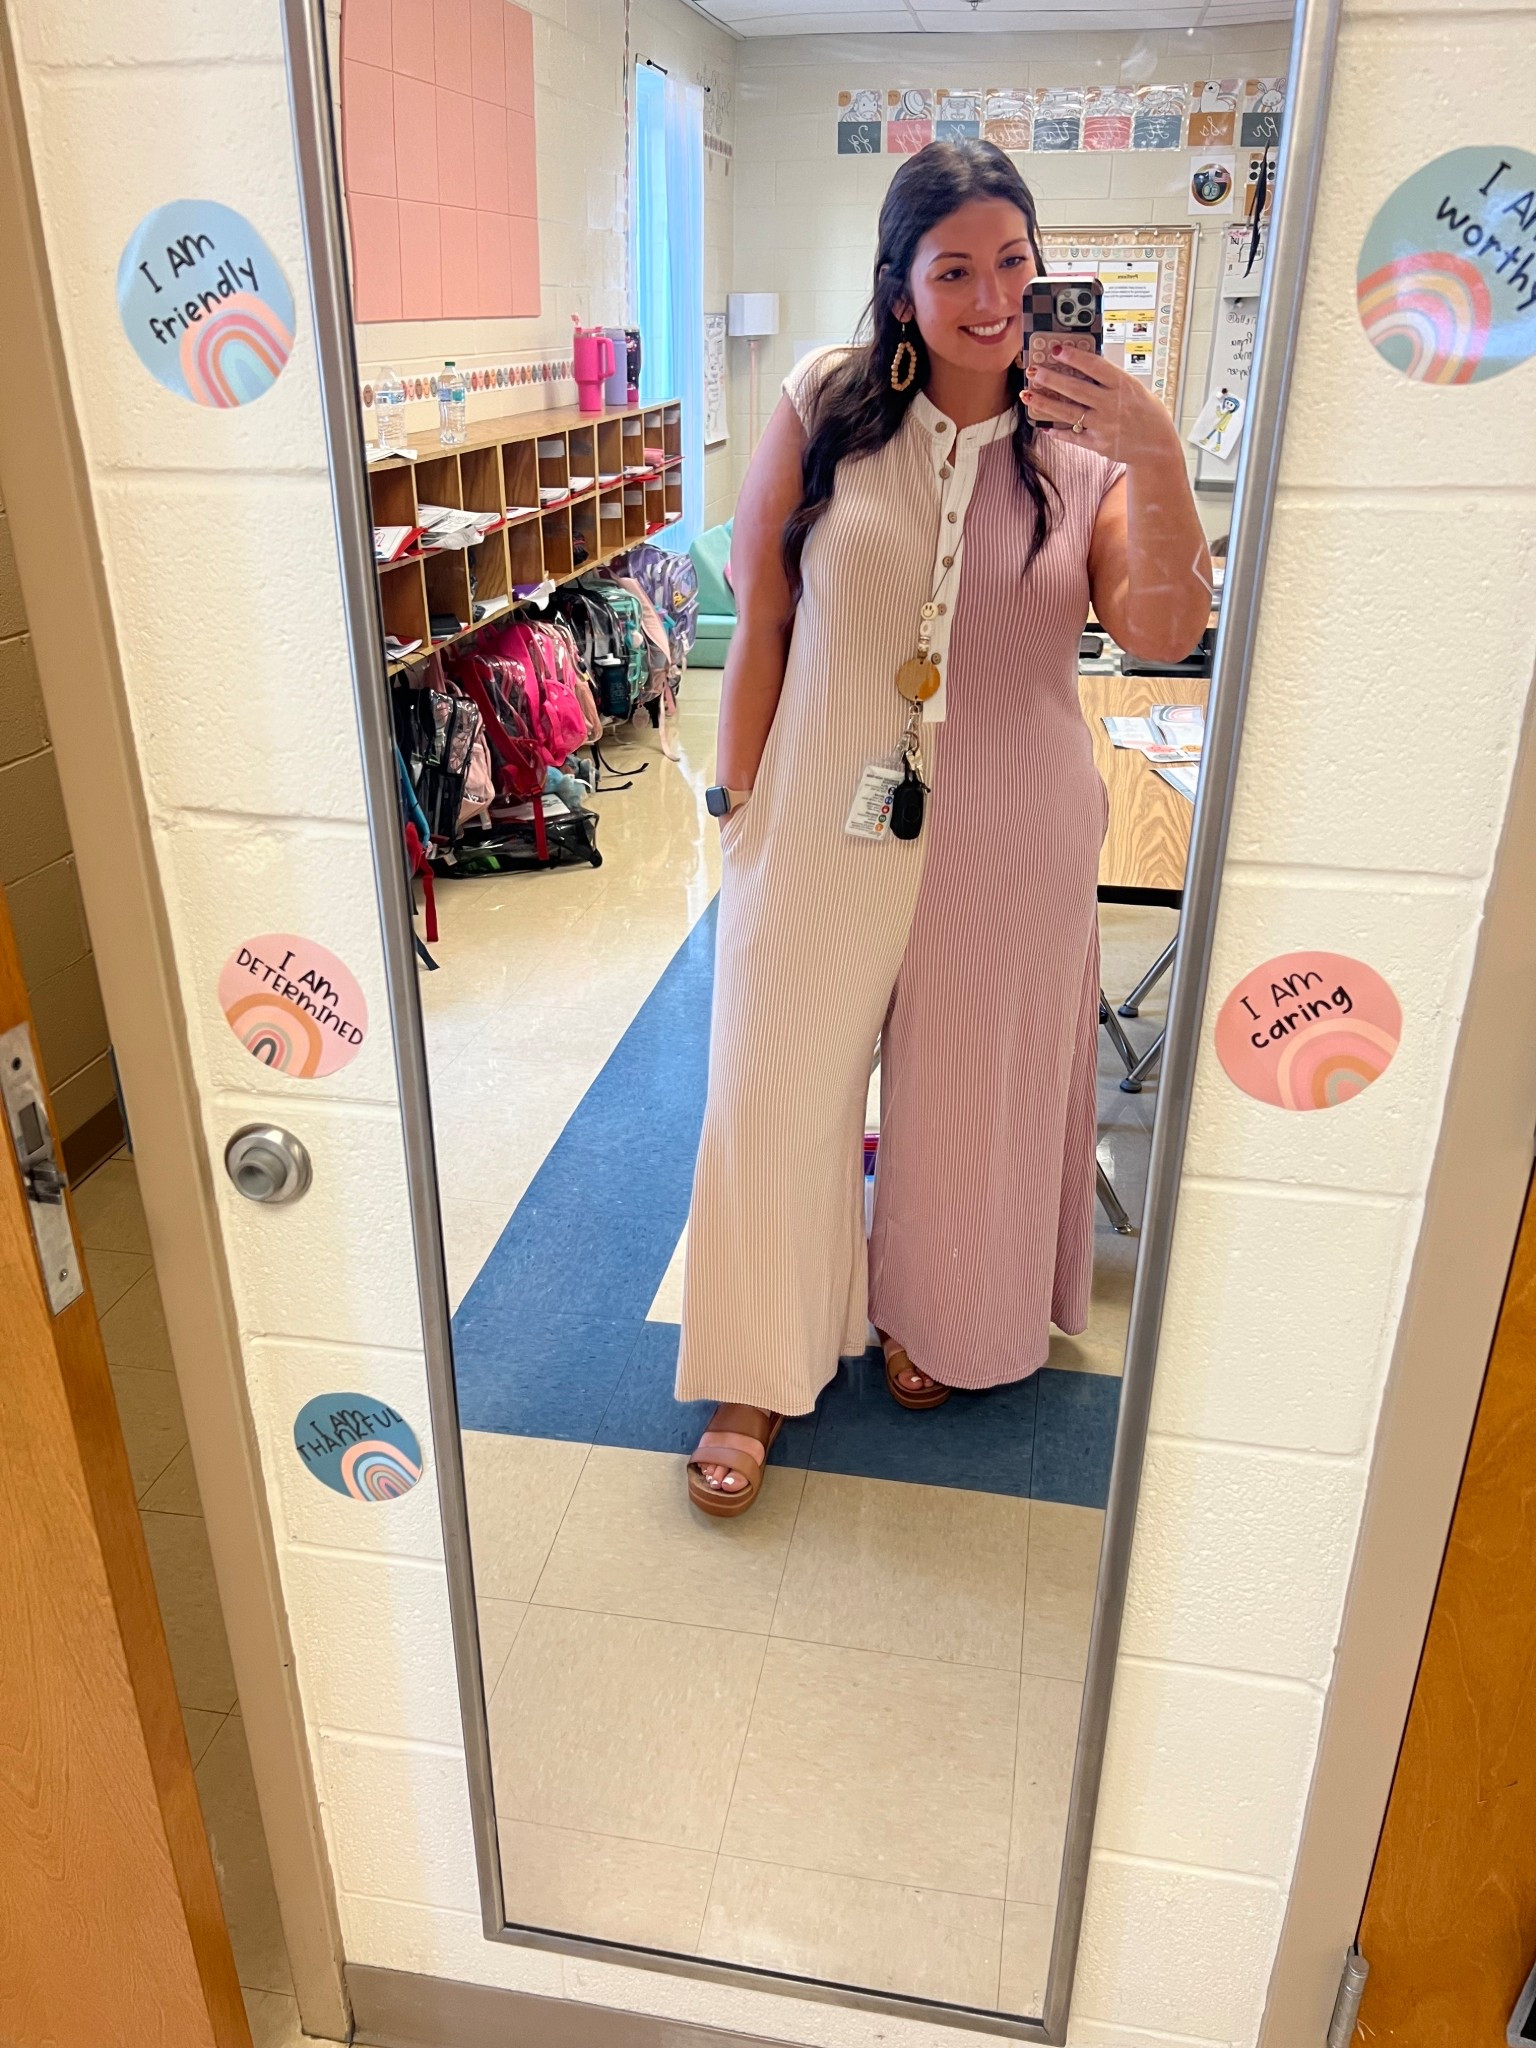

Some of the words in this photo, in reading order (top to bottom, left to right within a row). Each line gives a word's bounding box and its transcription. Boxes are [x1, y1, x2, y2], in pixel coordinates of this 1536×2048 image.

[1478, 160, 1512, 196] I
[139, 261, 162, 294] I
[148, 257, 259, 345] friendly
[279, 950, 296, 972] I
[236, 947, 363, 1045] DETERMINED
[1239, 996, 1261, 1020] I
[1251, 985, 1353, 1049] caring
[297, 1407, 403, 1462] THANKFUL
[310, 1421, 326, 1438] I
